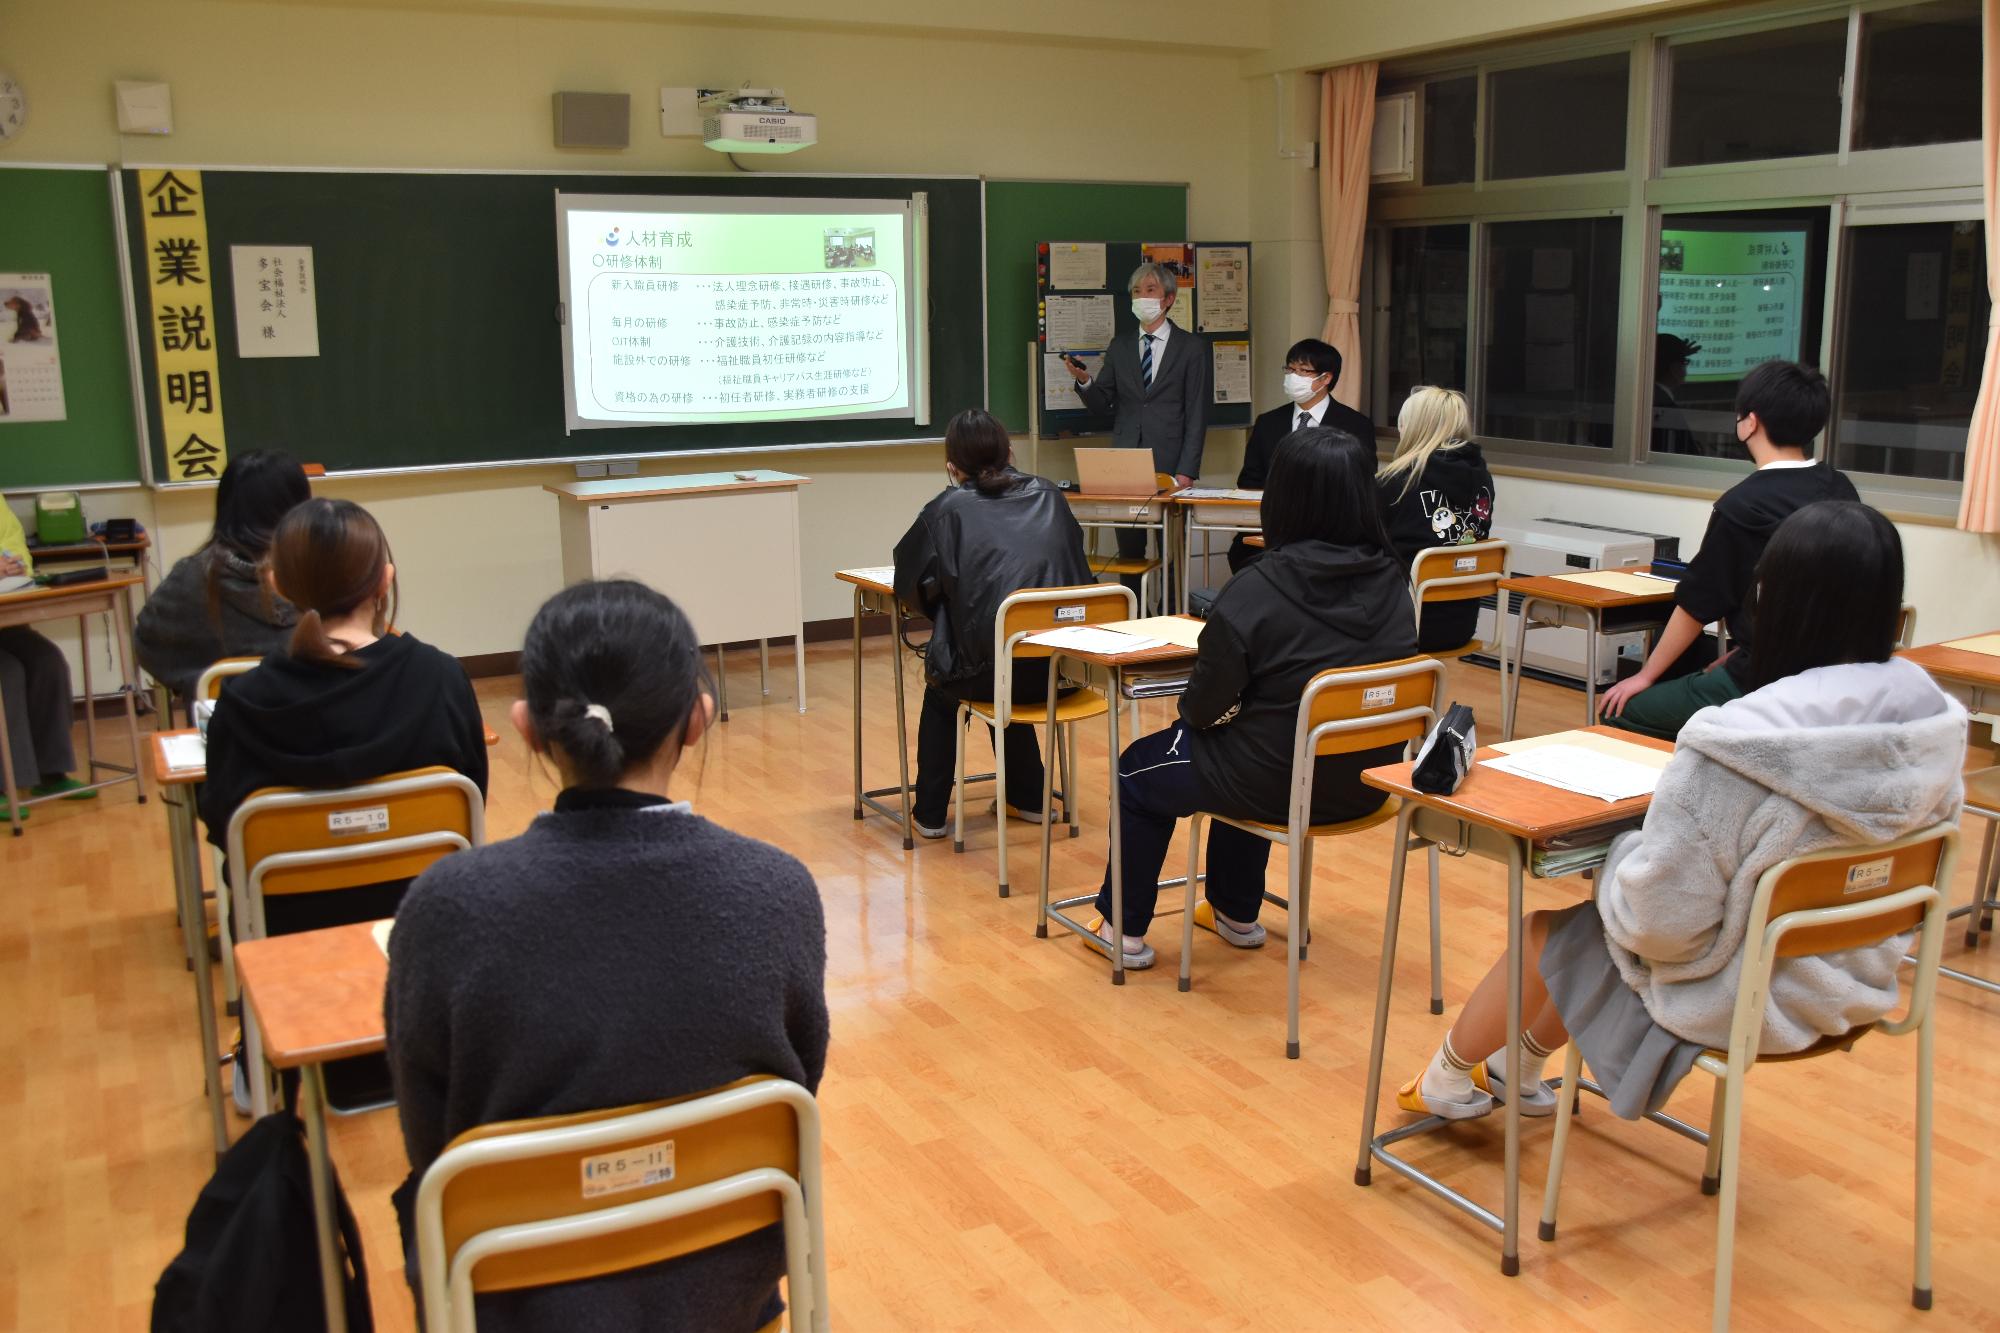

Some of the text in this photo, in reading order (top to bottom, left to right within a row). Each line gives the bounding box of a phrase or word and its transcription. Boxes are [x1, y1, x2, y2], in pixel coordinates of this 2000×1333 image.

[626, 230, 693, 248] 人材育成
[273, 257, 287, 319] 社会福祉法人
[612, 279, 679, 292] 新入職員研修
[148, 171, 222, 479] 企業説明会
[612, 316, 668, 329] 毎月の研修
[612, 336, 651, 348] OJT体制
[613, 354, 692, 367] 施設外での研修
[614, 391, 695, 404] 資格の為の研修
